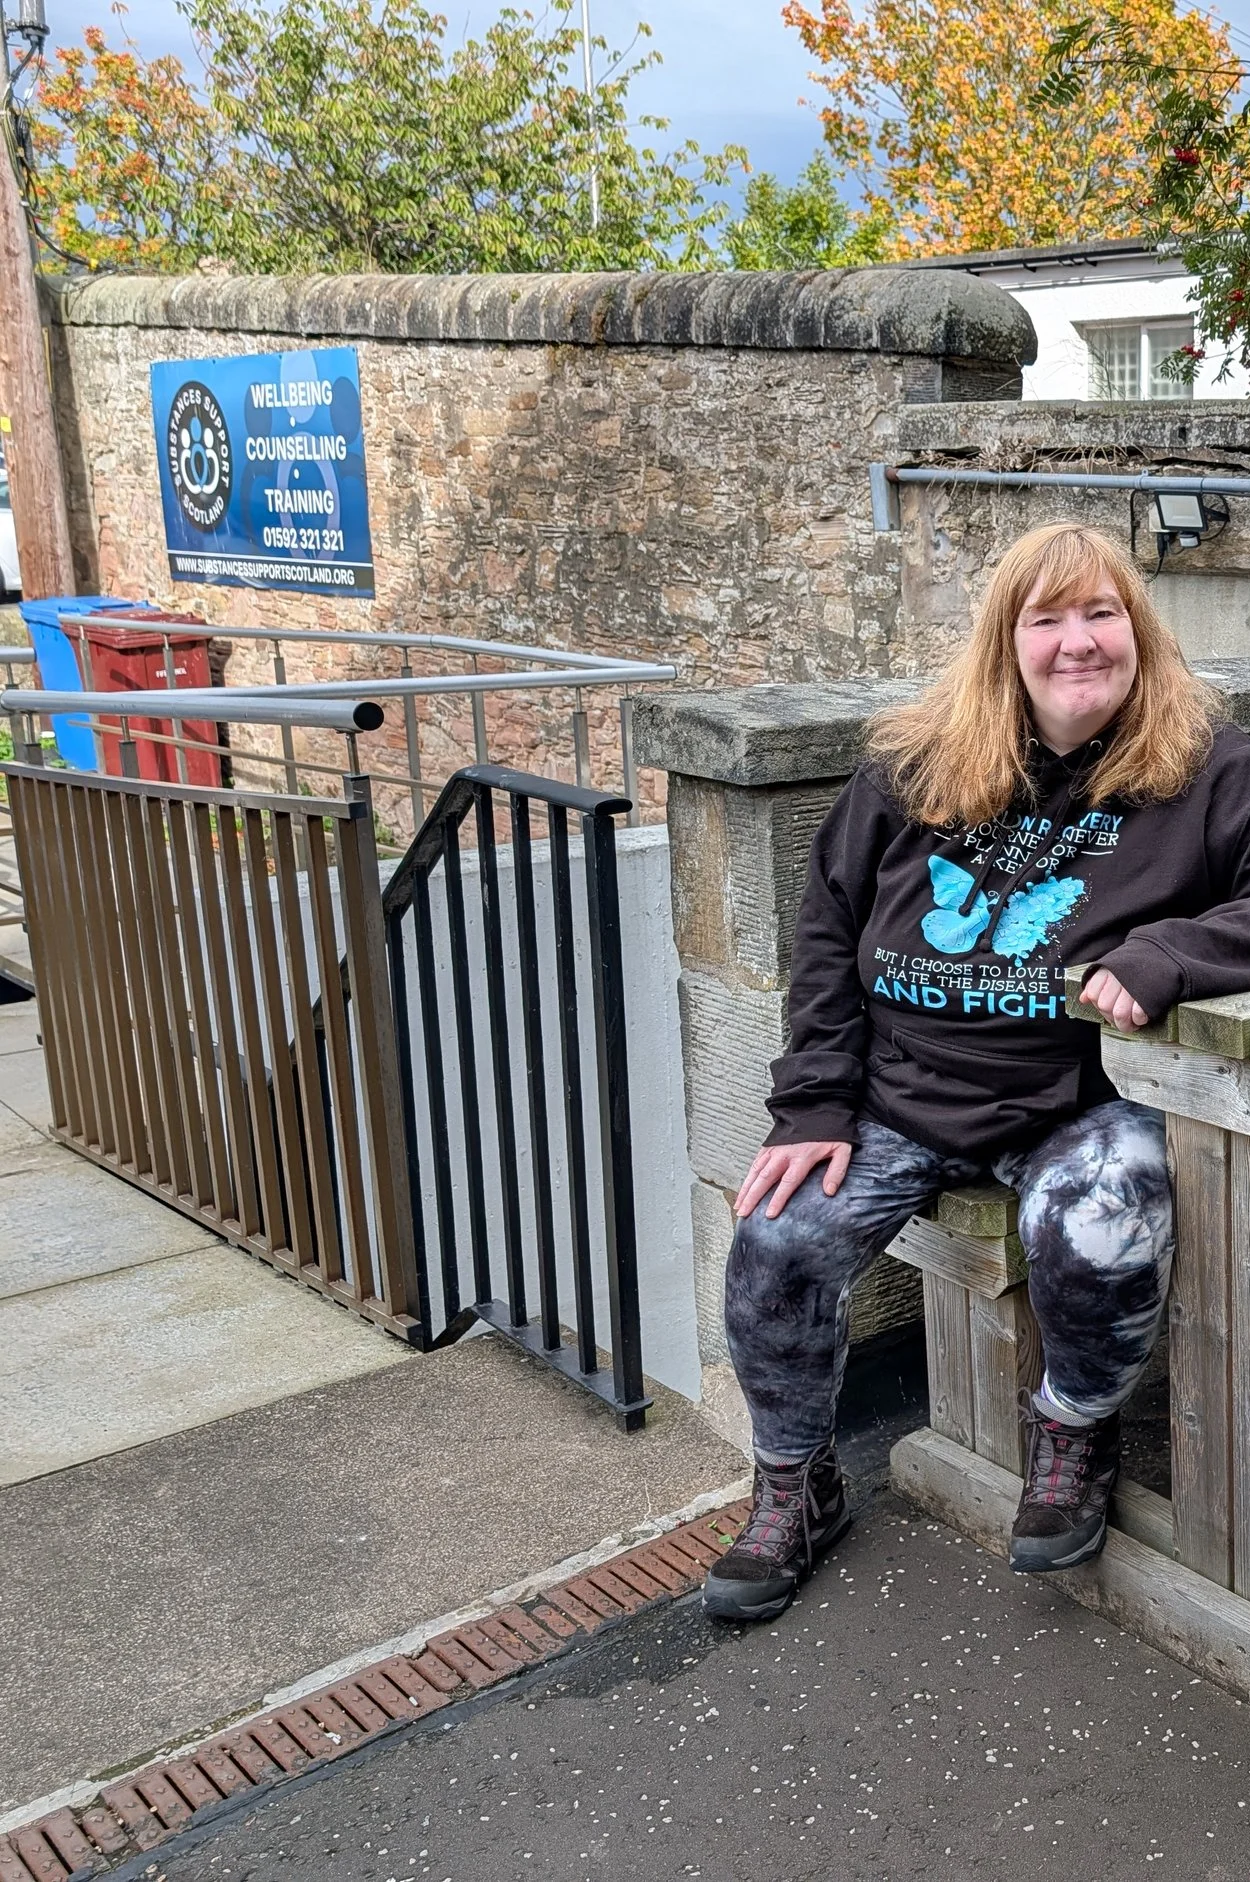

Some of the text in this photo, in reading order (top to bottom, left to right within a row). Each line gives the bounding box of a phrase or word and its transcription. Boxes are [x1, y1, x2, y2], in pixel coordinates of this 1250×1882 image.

[251, 380, 333, 408] WELLBEING
[169, 389, 230, 488] SUBSTANCES SUPPORT
[246, 435, 347, 461] COUNSELLING
[182, 494, 225, 525] SCOTLAND
[264, 489, 335, 514] TRAINING
[263, 527, 345, 551] 01592 321 321
[176, 557, 355, 585] WWW.SUBSTANCESSUPPORTSCOTLAND.ORG
[874, 947, 898, 964] BUT
[901, 955, 907, 967] I
[911, 957, 973, 976] CHOOSE
[979, 965, 1001, 978] TO
[1007, 966, 1048, 979] LOVE
[886, 966, 1050, 994] HATE THE DISEASE
[873, 975, 1067, 1020] AND FIGH
